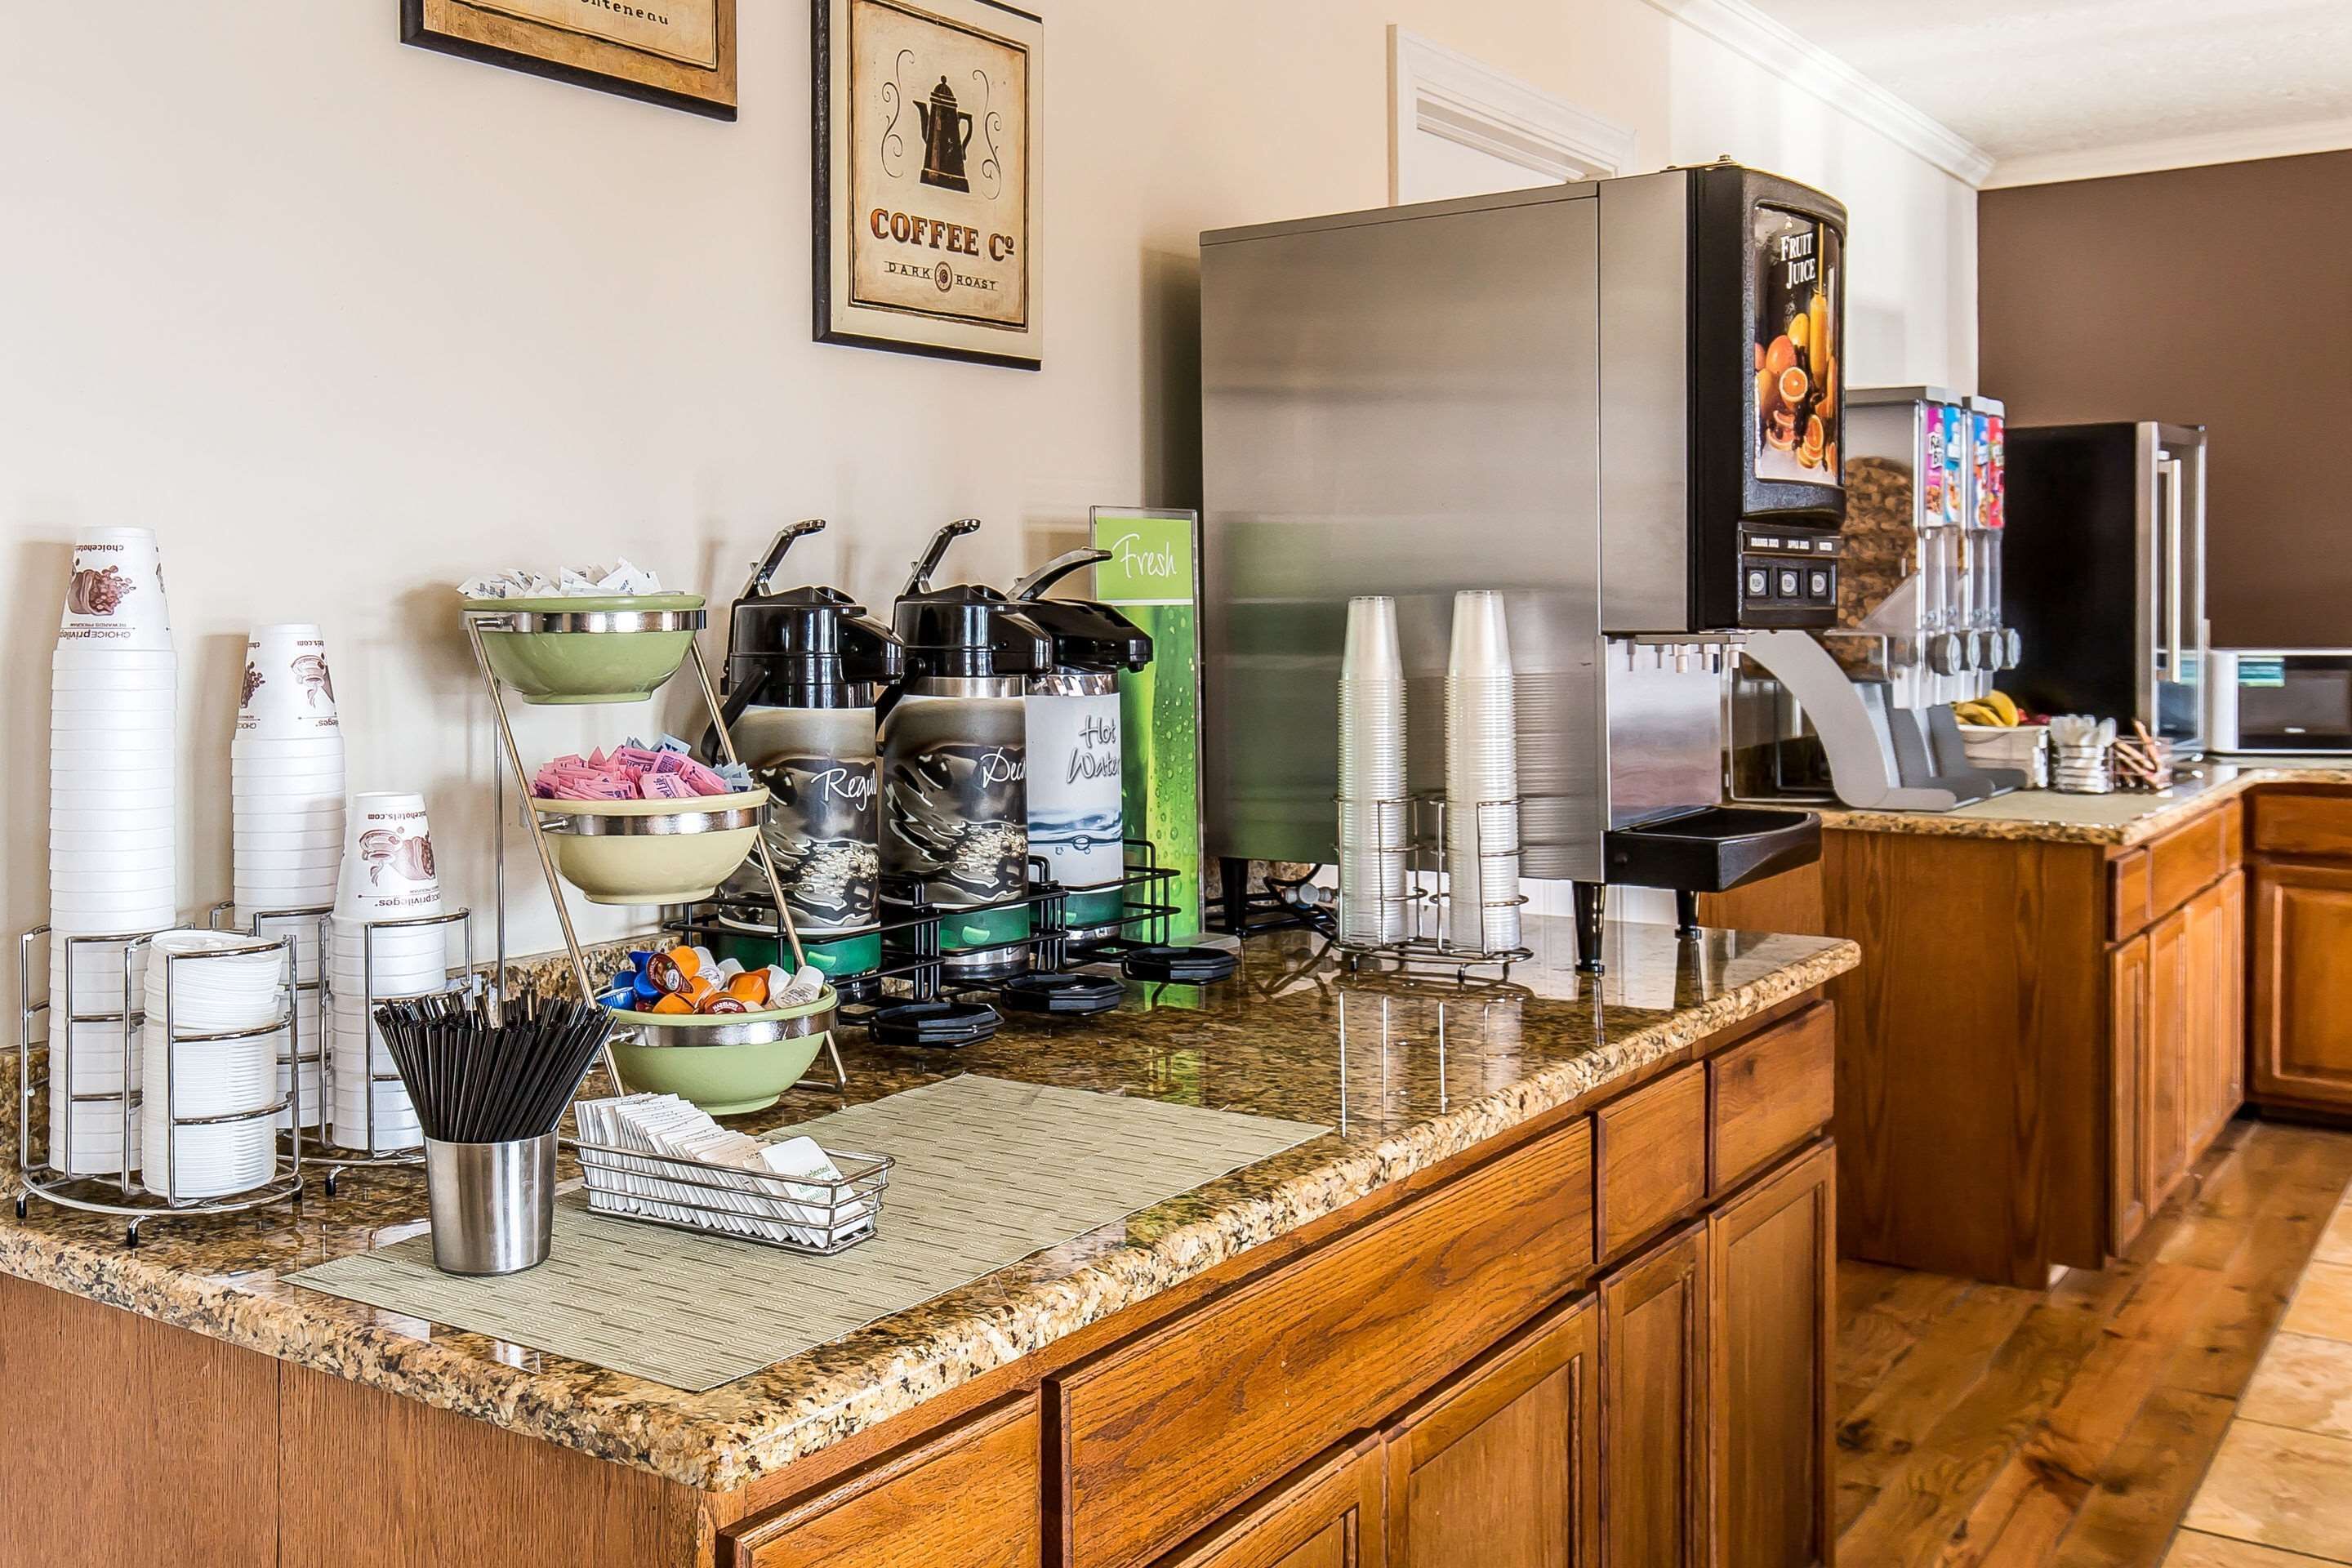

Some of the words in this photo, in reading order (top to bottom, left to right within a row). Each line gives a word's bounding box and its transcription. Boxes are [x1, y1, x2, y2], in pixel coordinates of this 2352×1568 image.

[581, 0, 669, 25] nteneau
[870, 207, 980, 256] COFFEE
[1780, 232, 1813, 261] FRUIT
[889, 261, 932, 279] DARK
[956, 274, 997, 291] ROAST
[1786, 258, 1815, 289] JUICE
[1111, 532, 1177, 578] Fresh
[1079, 715, 1117, 749] Hot
